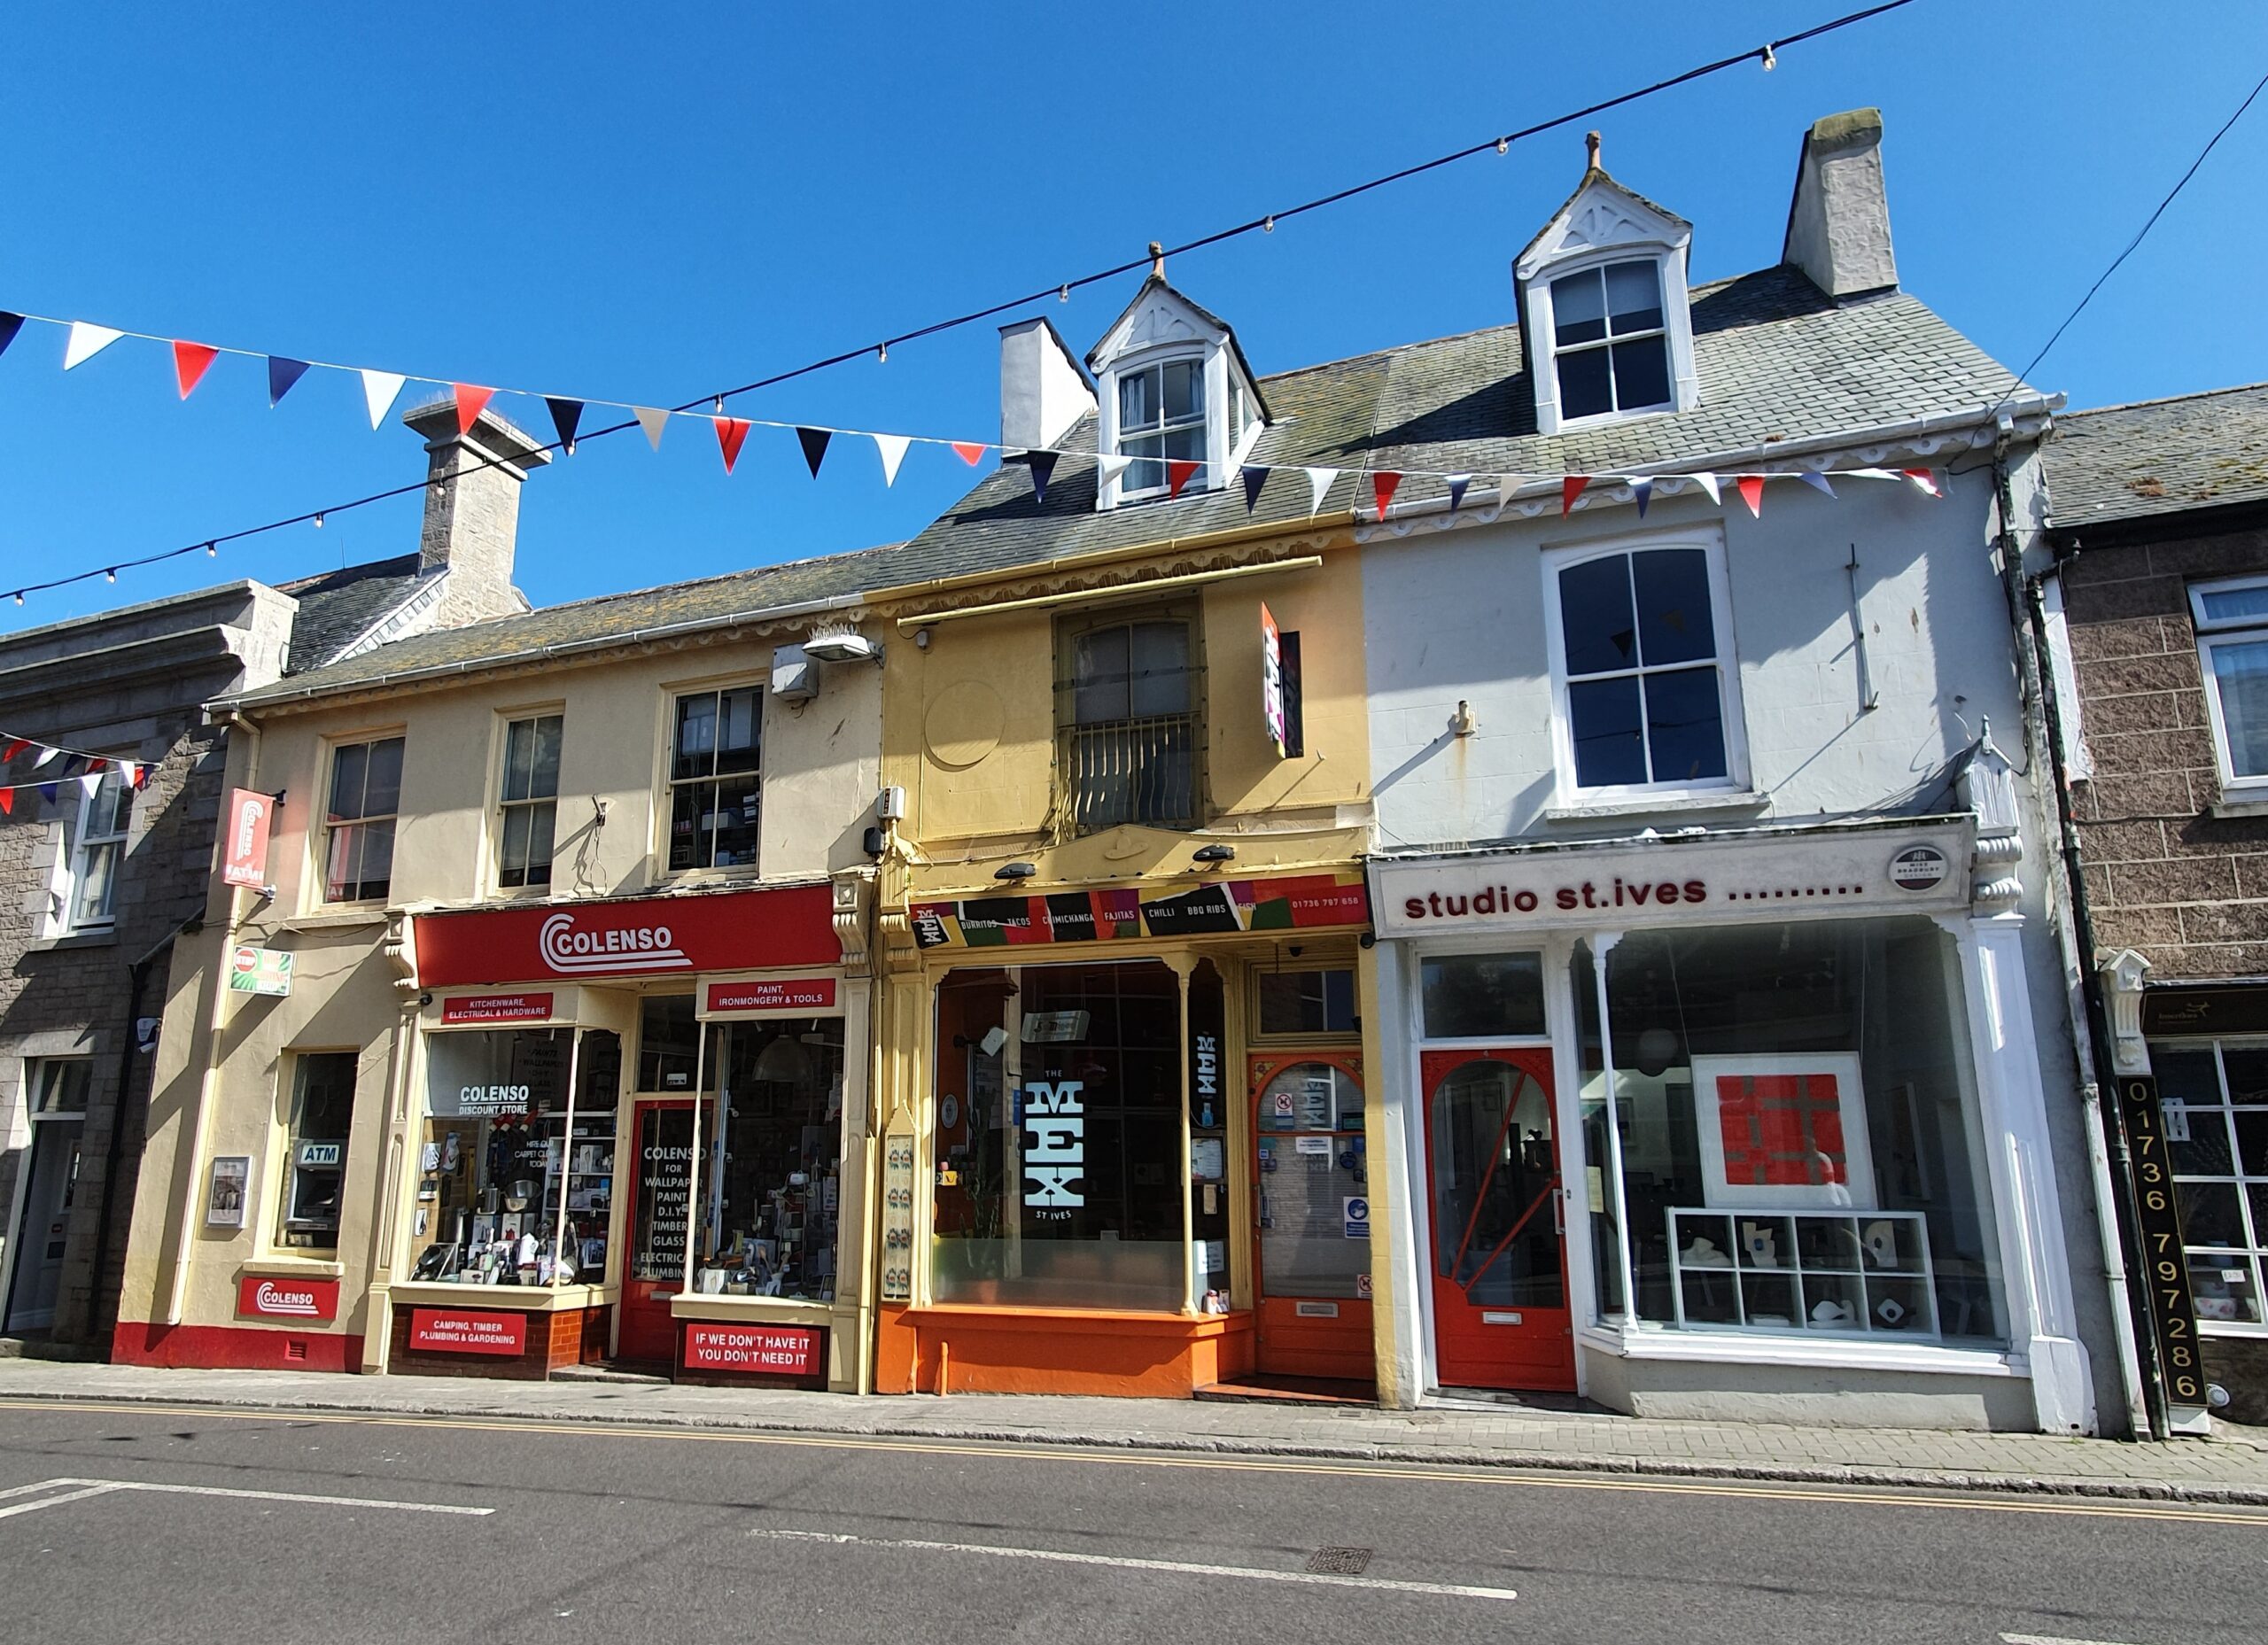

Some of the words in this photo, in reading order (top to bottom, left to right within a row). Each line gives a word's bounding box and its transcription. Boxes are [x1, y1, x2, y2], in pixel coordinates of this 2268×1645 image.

[1293, 899, 1319, 909] 01736
[1404, 886, 1539, 919] studio
[1556, 878, 1707, 910] st.ives
[1148, 908, 1175, 918] CHILLI
[1187, 905, 1204, 915] BBQ
[1207, 904, 1226, 914] RIBS
[1104, 911, 1135, 920] FAJITAS
[917, 909, 942, 943] MEX
[961, 919, 997, 929] BURRITOS
[1007, 917, 1030, 927] TACOS
[556, 927, 672, 955] COLENSO
[757, 985, 785, 995] PAINT,
[470, 998, 526, 1008] KITCHENWARE,
[718, 996, 784, 1006] IRONMONGERY
[785, 995, 791, 1004] &
[793, 994, 823, 1004] TOOLS
[448, 1010, 495, 1020] ELECTRICAL
[502, 1007, 547, 1017] HARDWARE
[1197, 1036, 1216, 1094] MEX
[460, 1085, 529, 1102] COLENSO
[459, 1105, 500, 1115] DISCOUNT
[501, 1105, 528, 1114] STORE
[1025, 1082, 1084, 1207] MEX
[305, 1146, 337, 1162] ATM
[664, 1164, 682, 1174] FOR
[645, 1177, 704, 1188] WALLPAPR
[656, 1192, 687, 1202] PAINT
[1036, 1211, 1046, 1220] ST
[1051, 1210, 1072, 1221] IVES
[652, 1221, 688, 1231] TIMBER
[652, 1236, 686, 1246] GLASS
[2129, 1082, 2167, 1211] 01736
[2152, 1233, 2197, 1397] 797286
[264, 1292, 313, 1305] COLENSO
[433, 1320, 471, 1331] CAMPING,
[472, 1322, 502, 1332] TIMBER
[420, 1331, 460, 1342] PLUMBING
[461, 1333, 467, 1342] &
[468, 1333, 516, 1345] GARDENING
[695, 1332, 707, 1345] IF
[708, 1333, 726, 1346] WE
[728, 1334, 764, 1347] DON'T
[765, 1336, 797, 1349] HAVE
[799, 1338, 811, 1350] IT
[698, 1348, 722, 1361] YOU
[724, 1350, 760, 1363] DON'T
[761, 1352, 794, 1365] NEED
[796, 1354, 807, 1366] IT
